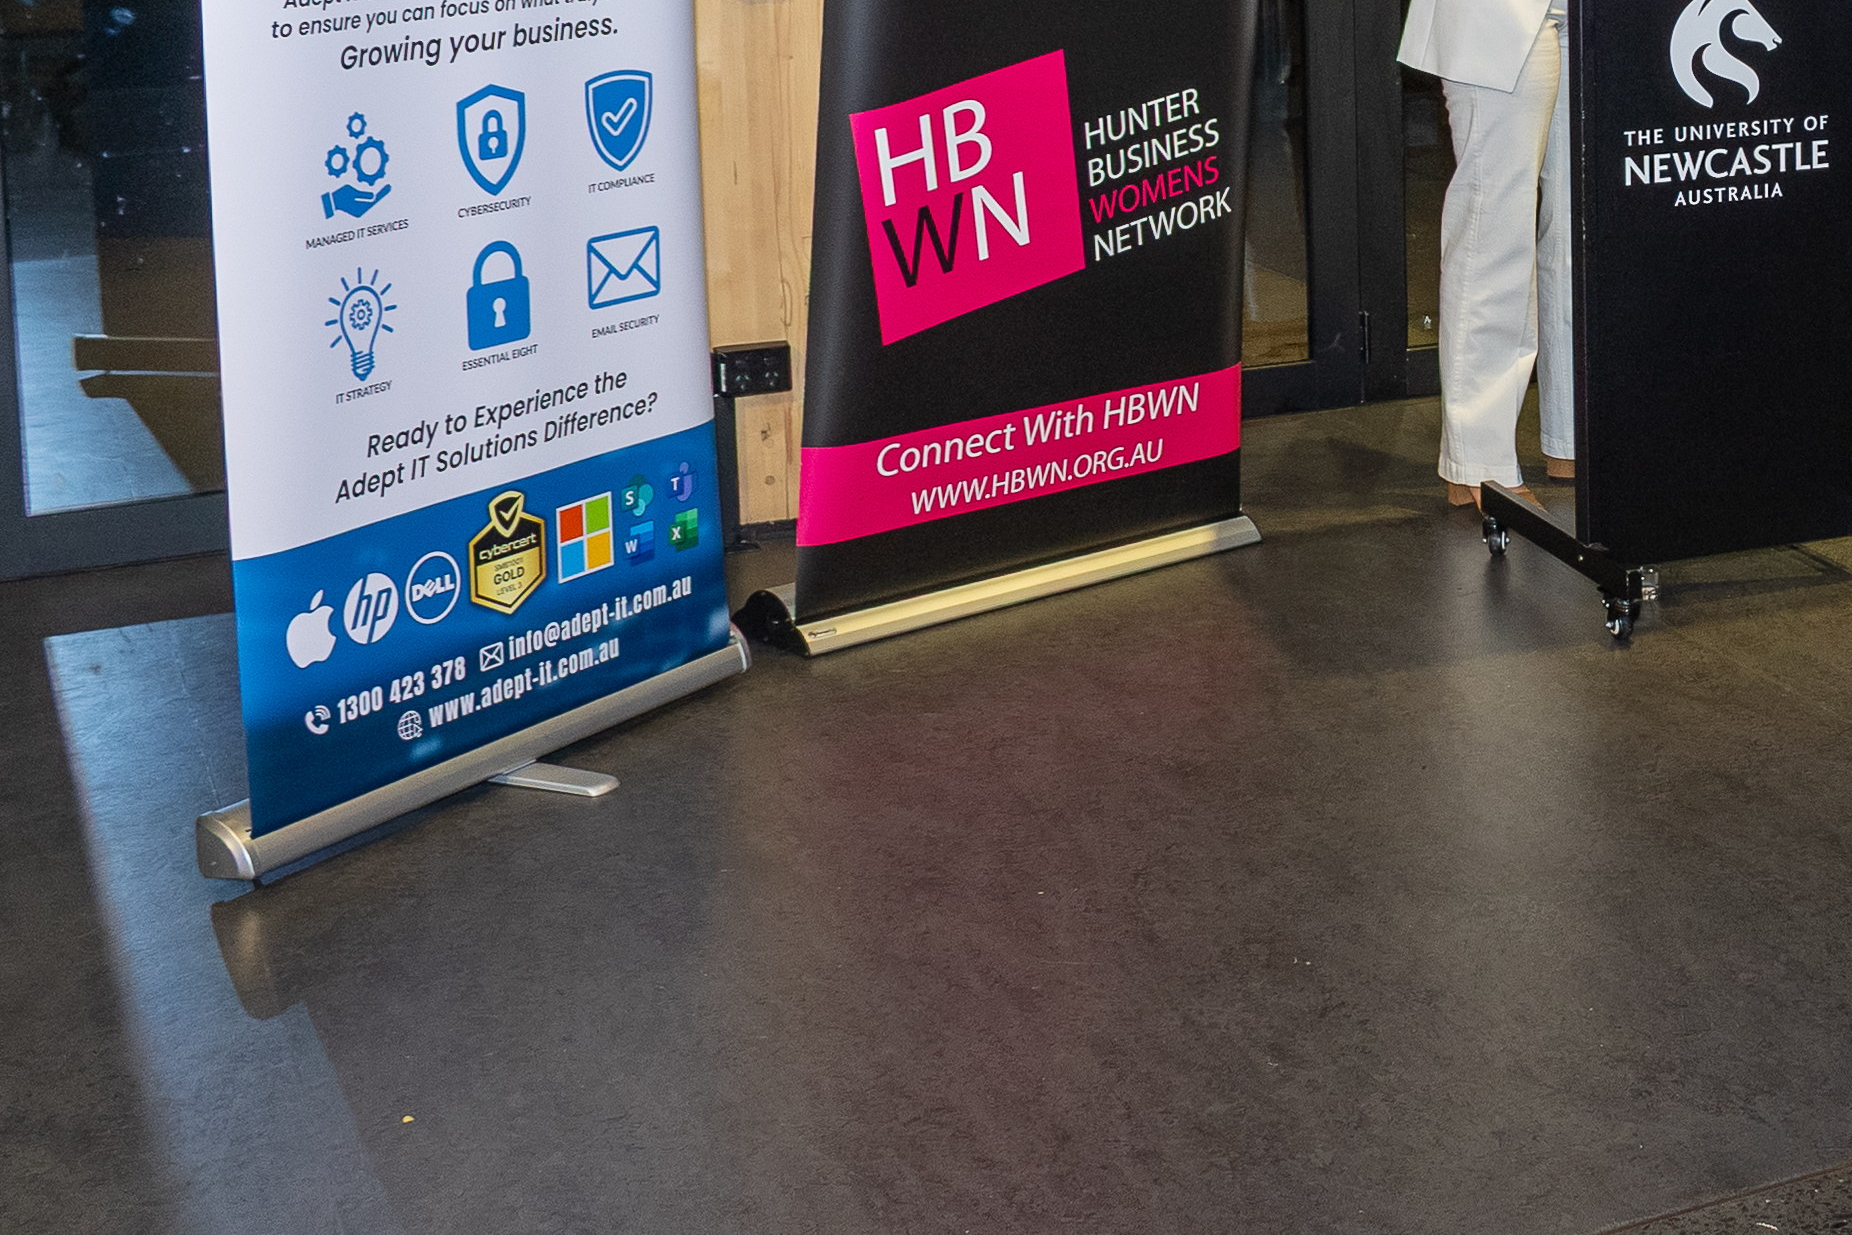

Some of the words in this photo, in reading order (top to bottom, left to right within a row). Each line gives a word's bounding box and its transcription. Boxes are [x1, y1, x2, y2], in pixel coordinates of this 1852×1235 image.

[270, 20, 292, 39] to
[298, 15, 361, 36] ensure
[366, 11, 397, 33] you
[402, 4, 434, 24] can
[341, 35, 442, 70] Growing
[449, 29, 507, 62] your
[513, 16, 618, 48] business.
[1084, 88, 1200, 149] HUNTER
[1623, 128, 1664, 146] THE
[1675, 118, 1794, 142] UNIVERSITY
[1804, 115, 1829, 131] OF
[874, 99, 993, 207] HB
[1088, 119, 1220, 187] BUSINESS
[1625, 139, 1829, 186] NEWCASTLE
[588, 183, 597, 193] IT
[598, 173, 655, 191] COMPLIANCE
[1089, 156, 1219, 223] WOMENS
[1675, 182, 1783, 207] AUSTRALIA
[458, 196, 532, 218] CYBERSECURITY
[882, 171, 1031, 288] WN
[1094, 187, 1232, 261] NETWORK
[305, 230, 355, 249] MANAGED
[357, 227, 366, 239] IT
[367, 219, 409, 237] SERVICES
[592, 324, 617, 338] EMAIL
[618, 315, 660, 333] SECURITY
[462, 351, 511, 371] ESSENTIAL
[512, 344, 538, 359] EIGHT
[336, 393, 344, 404] IT
[345, 380, 392, 402] STRATEGY
[367, 417, 439, 458] Ready
[445, 412, 467, 436] to
[473, 383, 589, 429] Experience
[594, 370, 628, 398] the
[336, 463, 405, 504] Adept
[411, 456, 430, 481] IT
[436, 429, 538, 473] Solutions
[545, 392, 658, 443] Difference?
[876, 422, 1016, 477] Connect
[1022, 403, 1094, 444] With
[1102, 382, 1200, 430] HBWN
[625, 491, 634, 506] S
[911, 439, 1164, 515] WWW.HBWN.ORG.AU
[478, 532, 537, 561] cybercert
[625, 539, 638, 554] W
[671, 527, 681, 540] X
[411, 571, 456, 603] DELL
[494, 567, 524, 585] GOLD
[354, 575, 393, 644] hp
[508, 576, 692, 661] info@adept-it.com.au
[337, 693, 383, 723] 1300
[389, 669, 425, 704] 423
[431, 656, 466, 692] 378
[428, 636, 620, 728] www.adept-it.com.au
